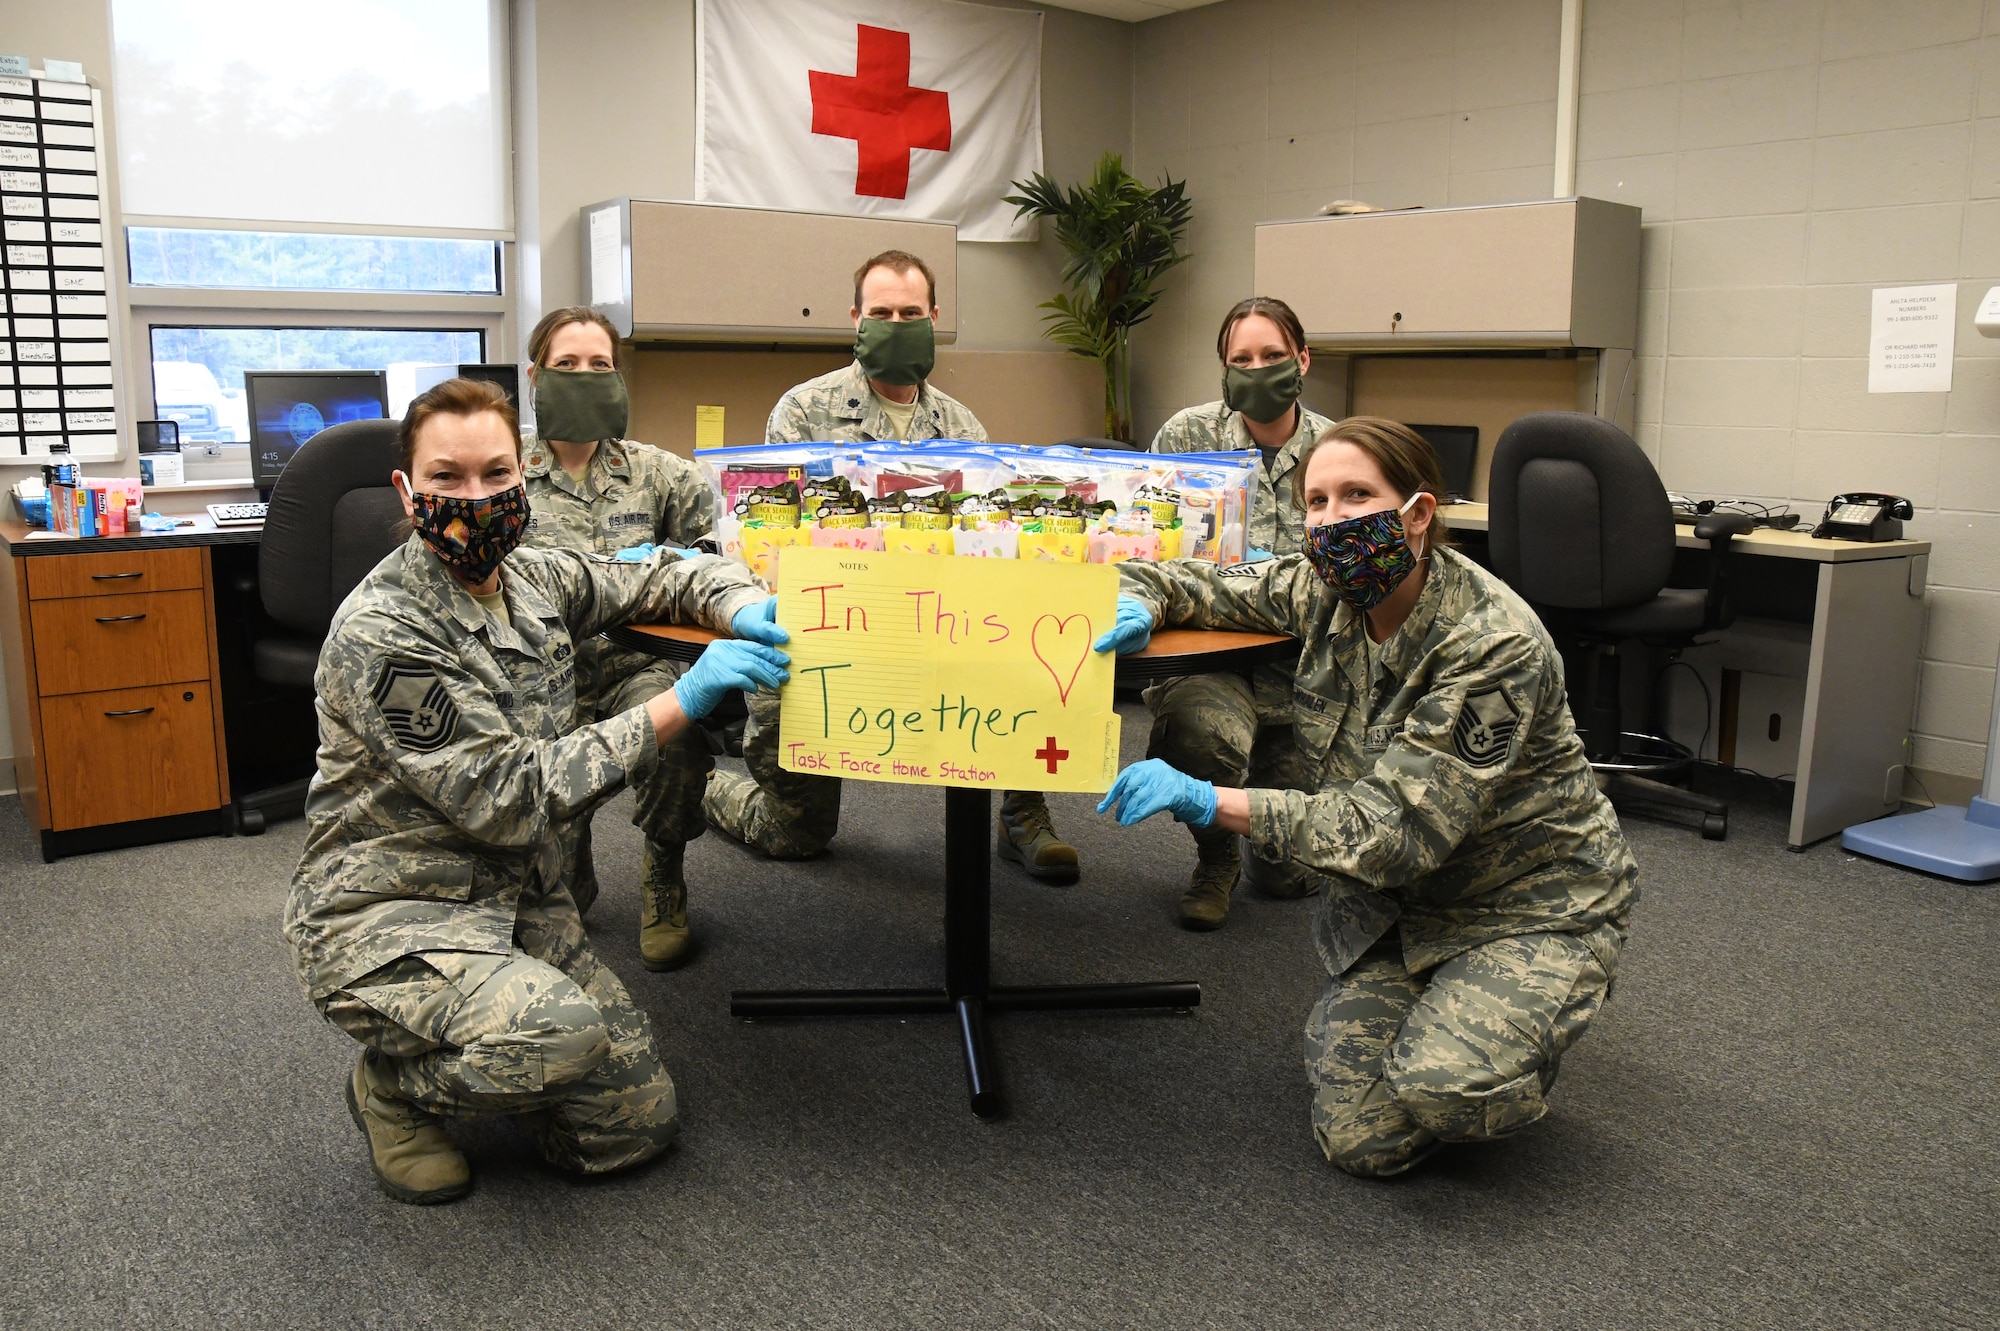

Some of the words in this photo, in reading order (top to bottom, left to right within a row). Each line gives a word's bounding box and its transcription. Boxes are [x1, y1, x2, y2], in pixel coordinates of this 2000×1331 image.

[60, 229, 81, 237] SME
[1908, 296, 1937, 304] HELPDESK
[261, 452, 279, 461] 4:15
[790, 470, 799, 478] $1
[99, 494, 107, 514] Hefty
[623, 514, 636, 525] AIR
[838, 562, 869, 571] NOTES
[801, 584, 869, 633] In
[905, 591, 1010, 644] This
[800, 664, 1038, 757] Together
[787, 743, 830, 770] Task
[838, 752, 881, 775] Force
[892, 760, 931, 778] Home
[939, 761, 996, 782] Station
